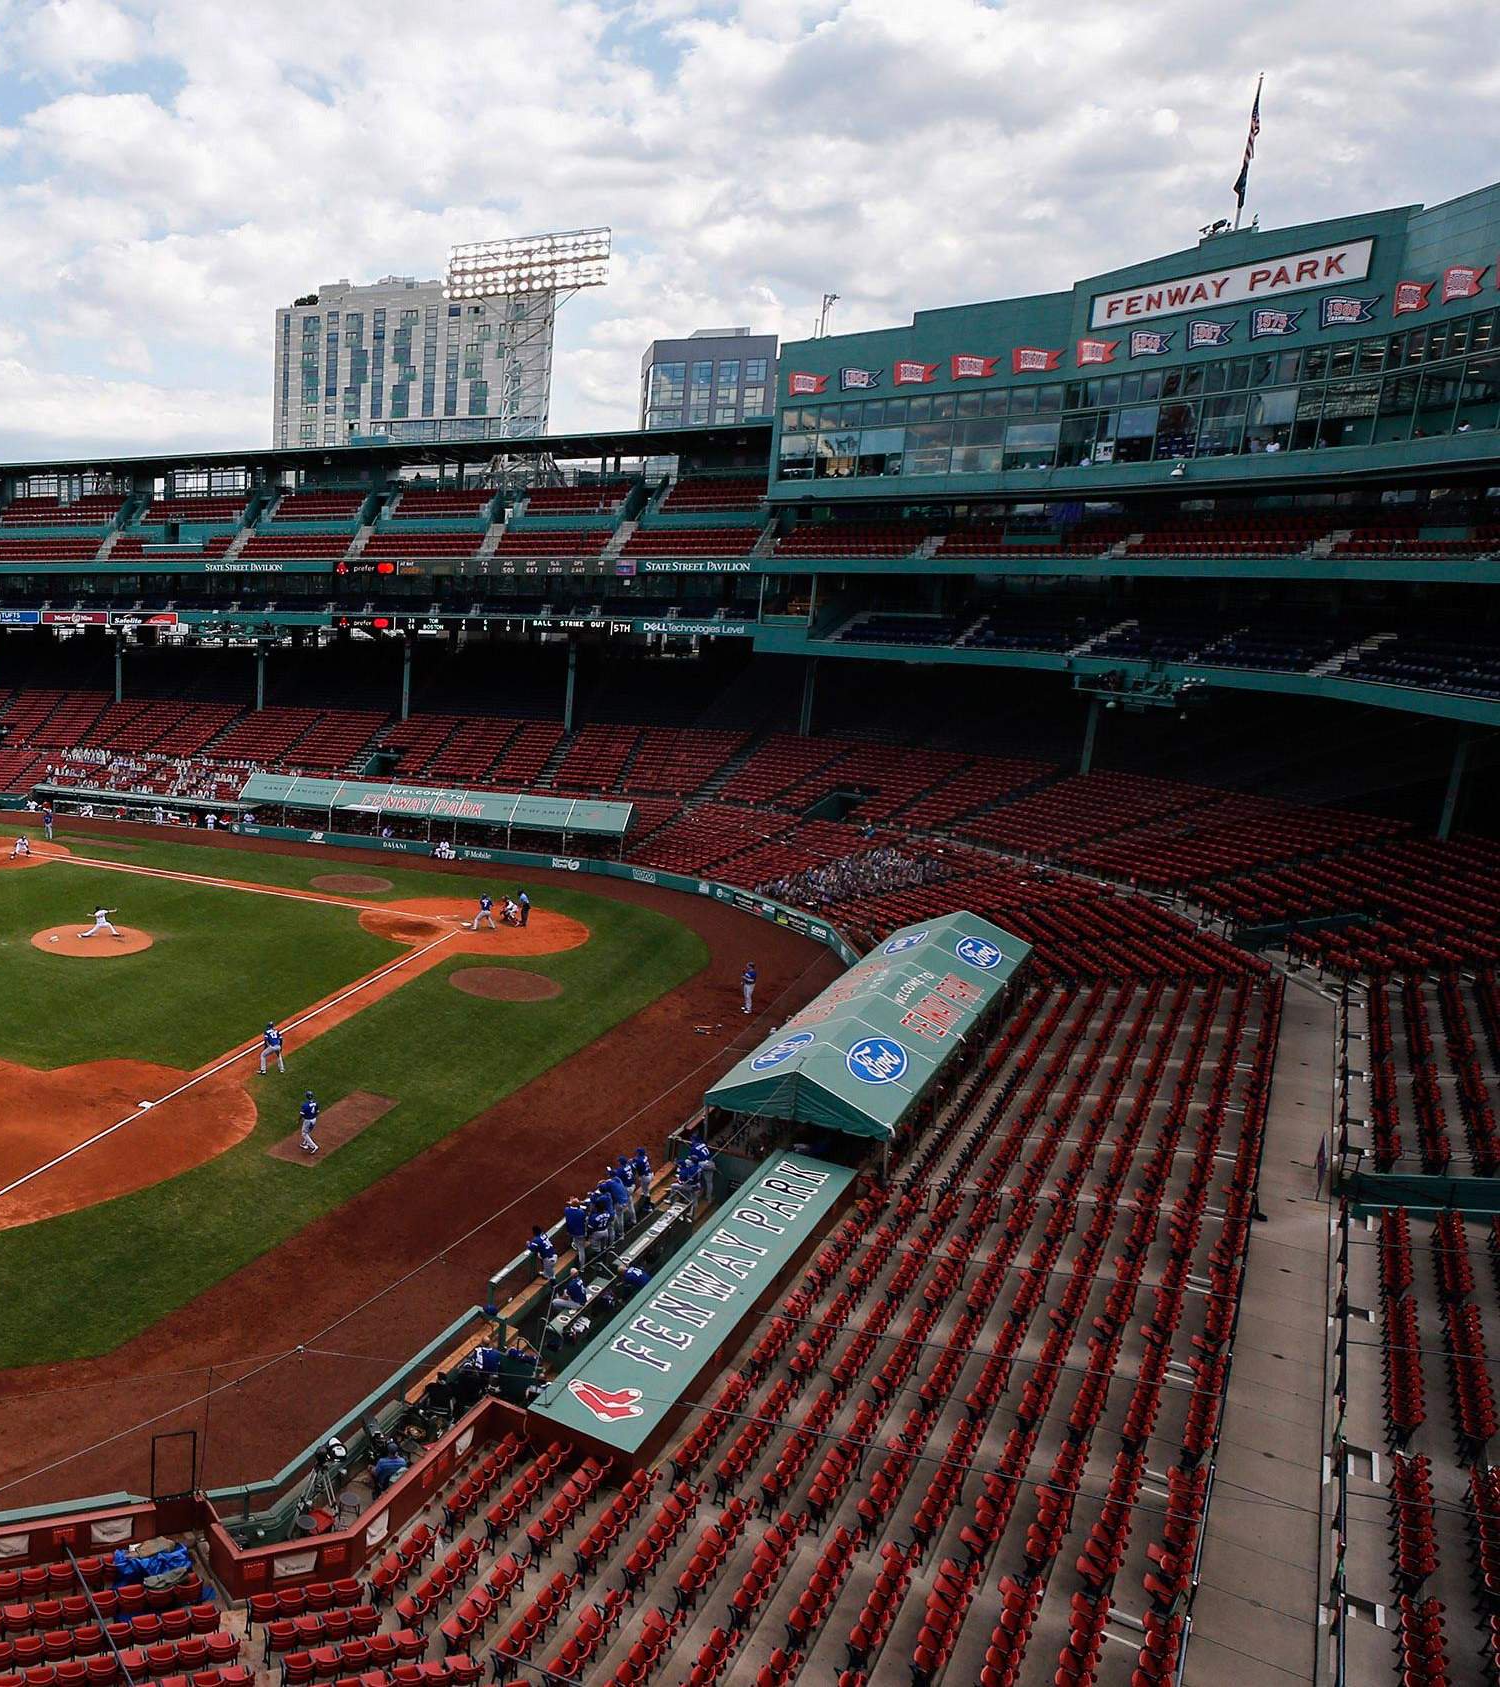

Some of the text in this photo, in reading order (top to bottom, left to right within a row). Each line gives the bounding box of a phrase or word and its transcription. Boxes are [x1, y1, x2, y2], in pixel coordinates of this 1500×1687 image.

[1107, 252, 1348, 319] FENWAY PARK
[1327, 303, 1361, 317] 1986
[1257, 315, 1288, 328] 1975
[205, 563, 283, 571] STATE STREET PAVILION
[353, 565, 375, 573] prefer
[645, 562, 751, 571] STATE STREET PAVILION
[114, 617, 142, 625] Safelite
[613, 624, 631, 633] 5TH
[643, 622, 745, 634] DELL Technologies Level
[392, 788, 446, 797] WELCOME
[361, 793, 484, 817] FENWAY PARK
[383, 841, 407, 850] DASANI
[470, 850, 492, 859] Mobile
[959, 941, 999, 967] Ford
[853, 1044, 902, 1085] Ford
[610, 1160, 831, 1373] FENWAY PARK
